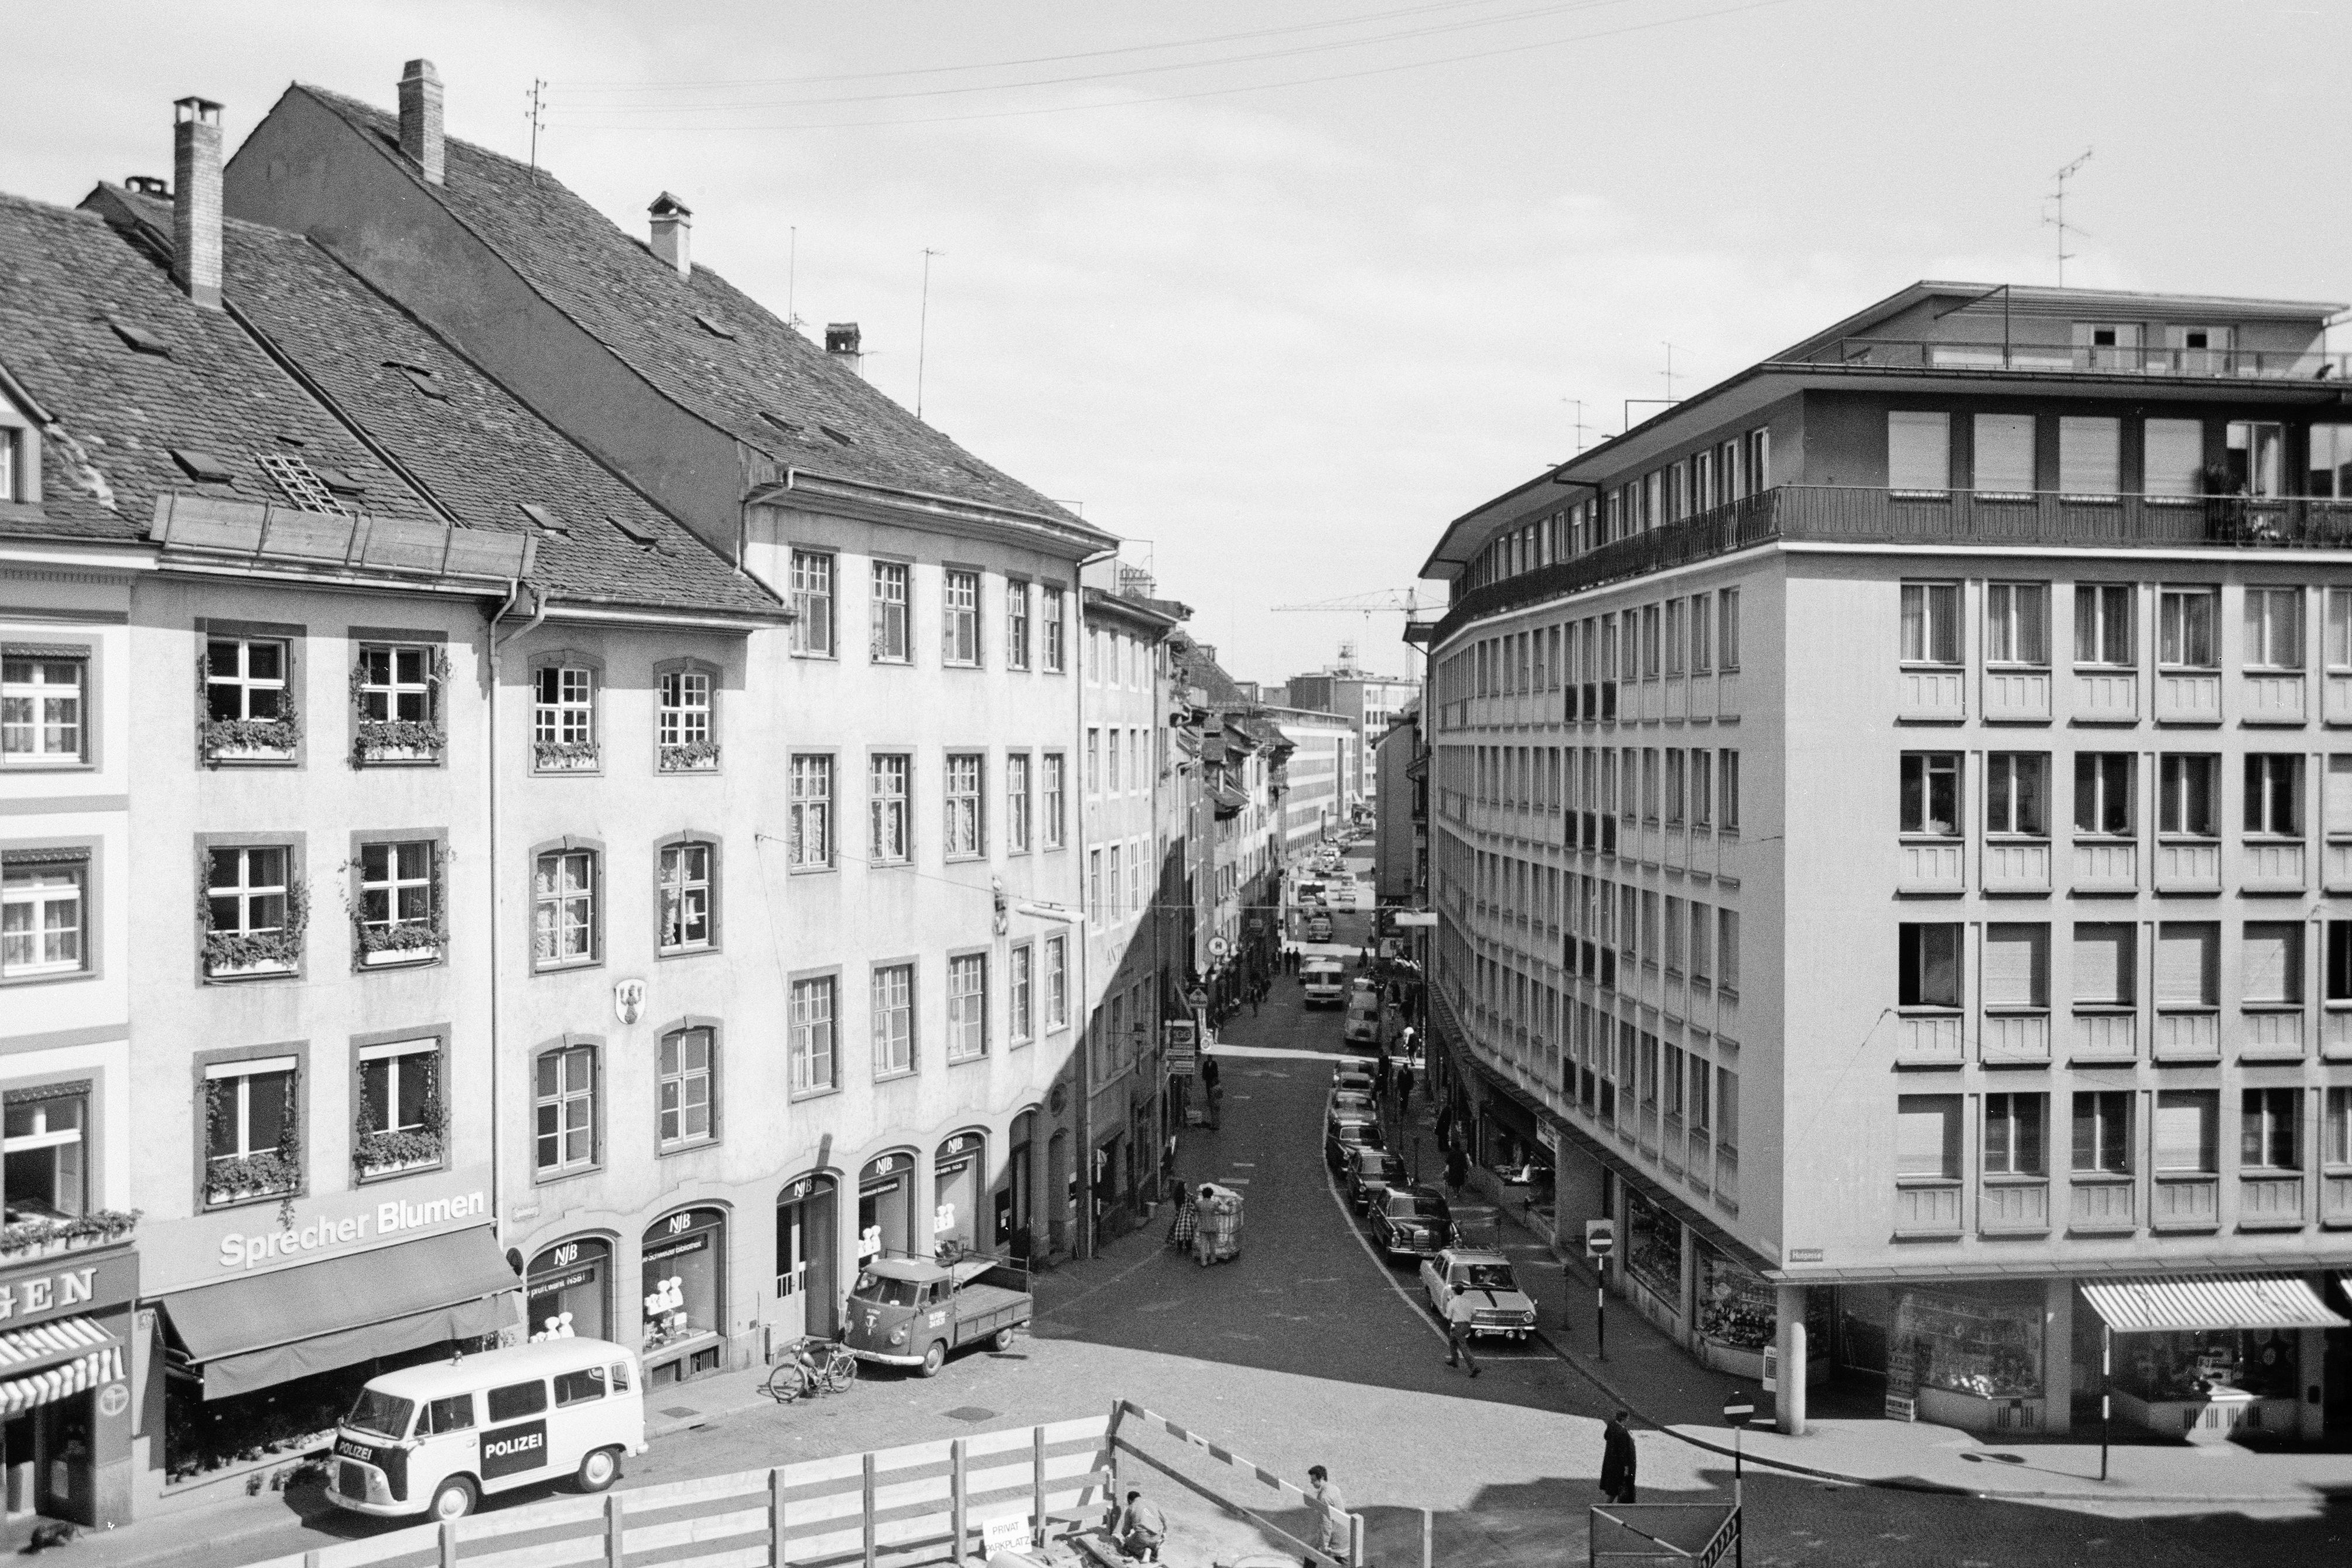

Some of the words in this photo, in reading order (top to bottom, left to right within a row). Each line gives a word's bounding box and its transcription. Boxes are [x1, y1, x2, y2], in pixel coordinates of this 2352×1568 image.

[219, 1214, 370, 1269] Sprecher
[377, 1190, 484, 1234] Blumen
[339, 1442, 372, 1461] POLIZEI
[486, 1433, 542, 1459] POLIZEI
[992, 1521, 1020, 1535] PRIVAT
[985, 1536, 1031, 1553] PARKPLATZ
